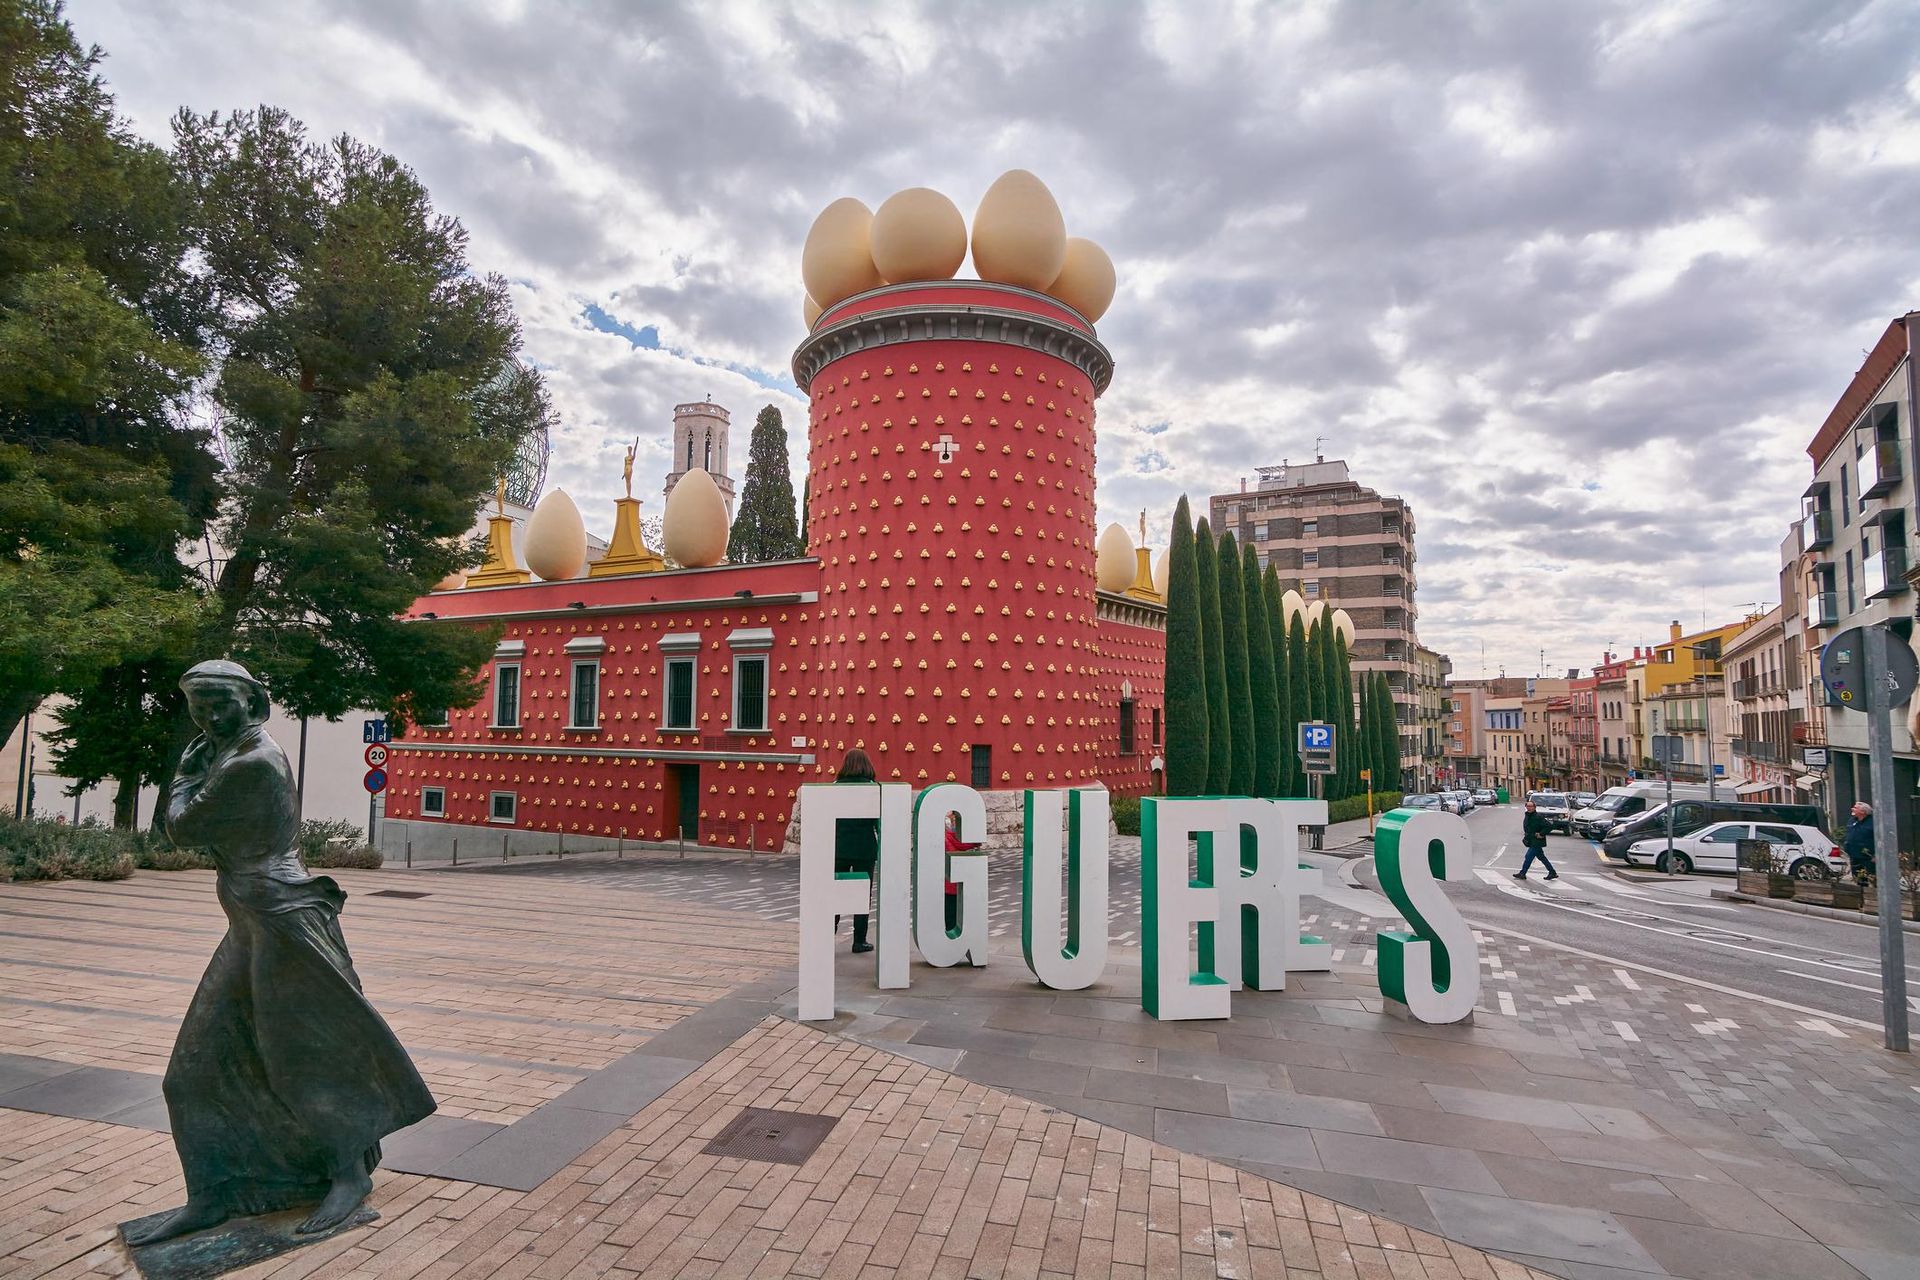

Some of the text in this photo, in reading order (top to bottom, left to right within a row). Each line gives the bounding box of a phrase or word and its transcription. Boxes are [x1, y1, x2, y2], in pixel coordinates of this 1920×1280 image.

[1312, 728, 1328, 746] P
[371, 751, 385, 760] 20
[798, 782, 1481, 1024] FIGUERES
